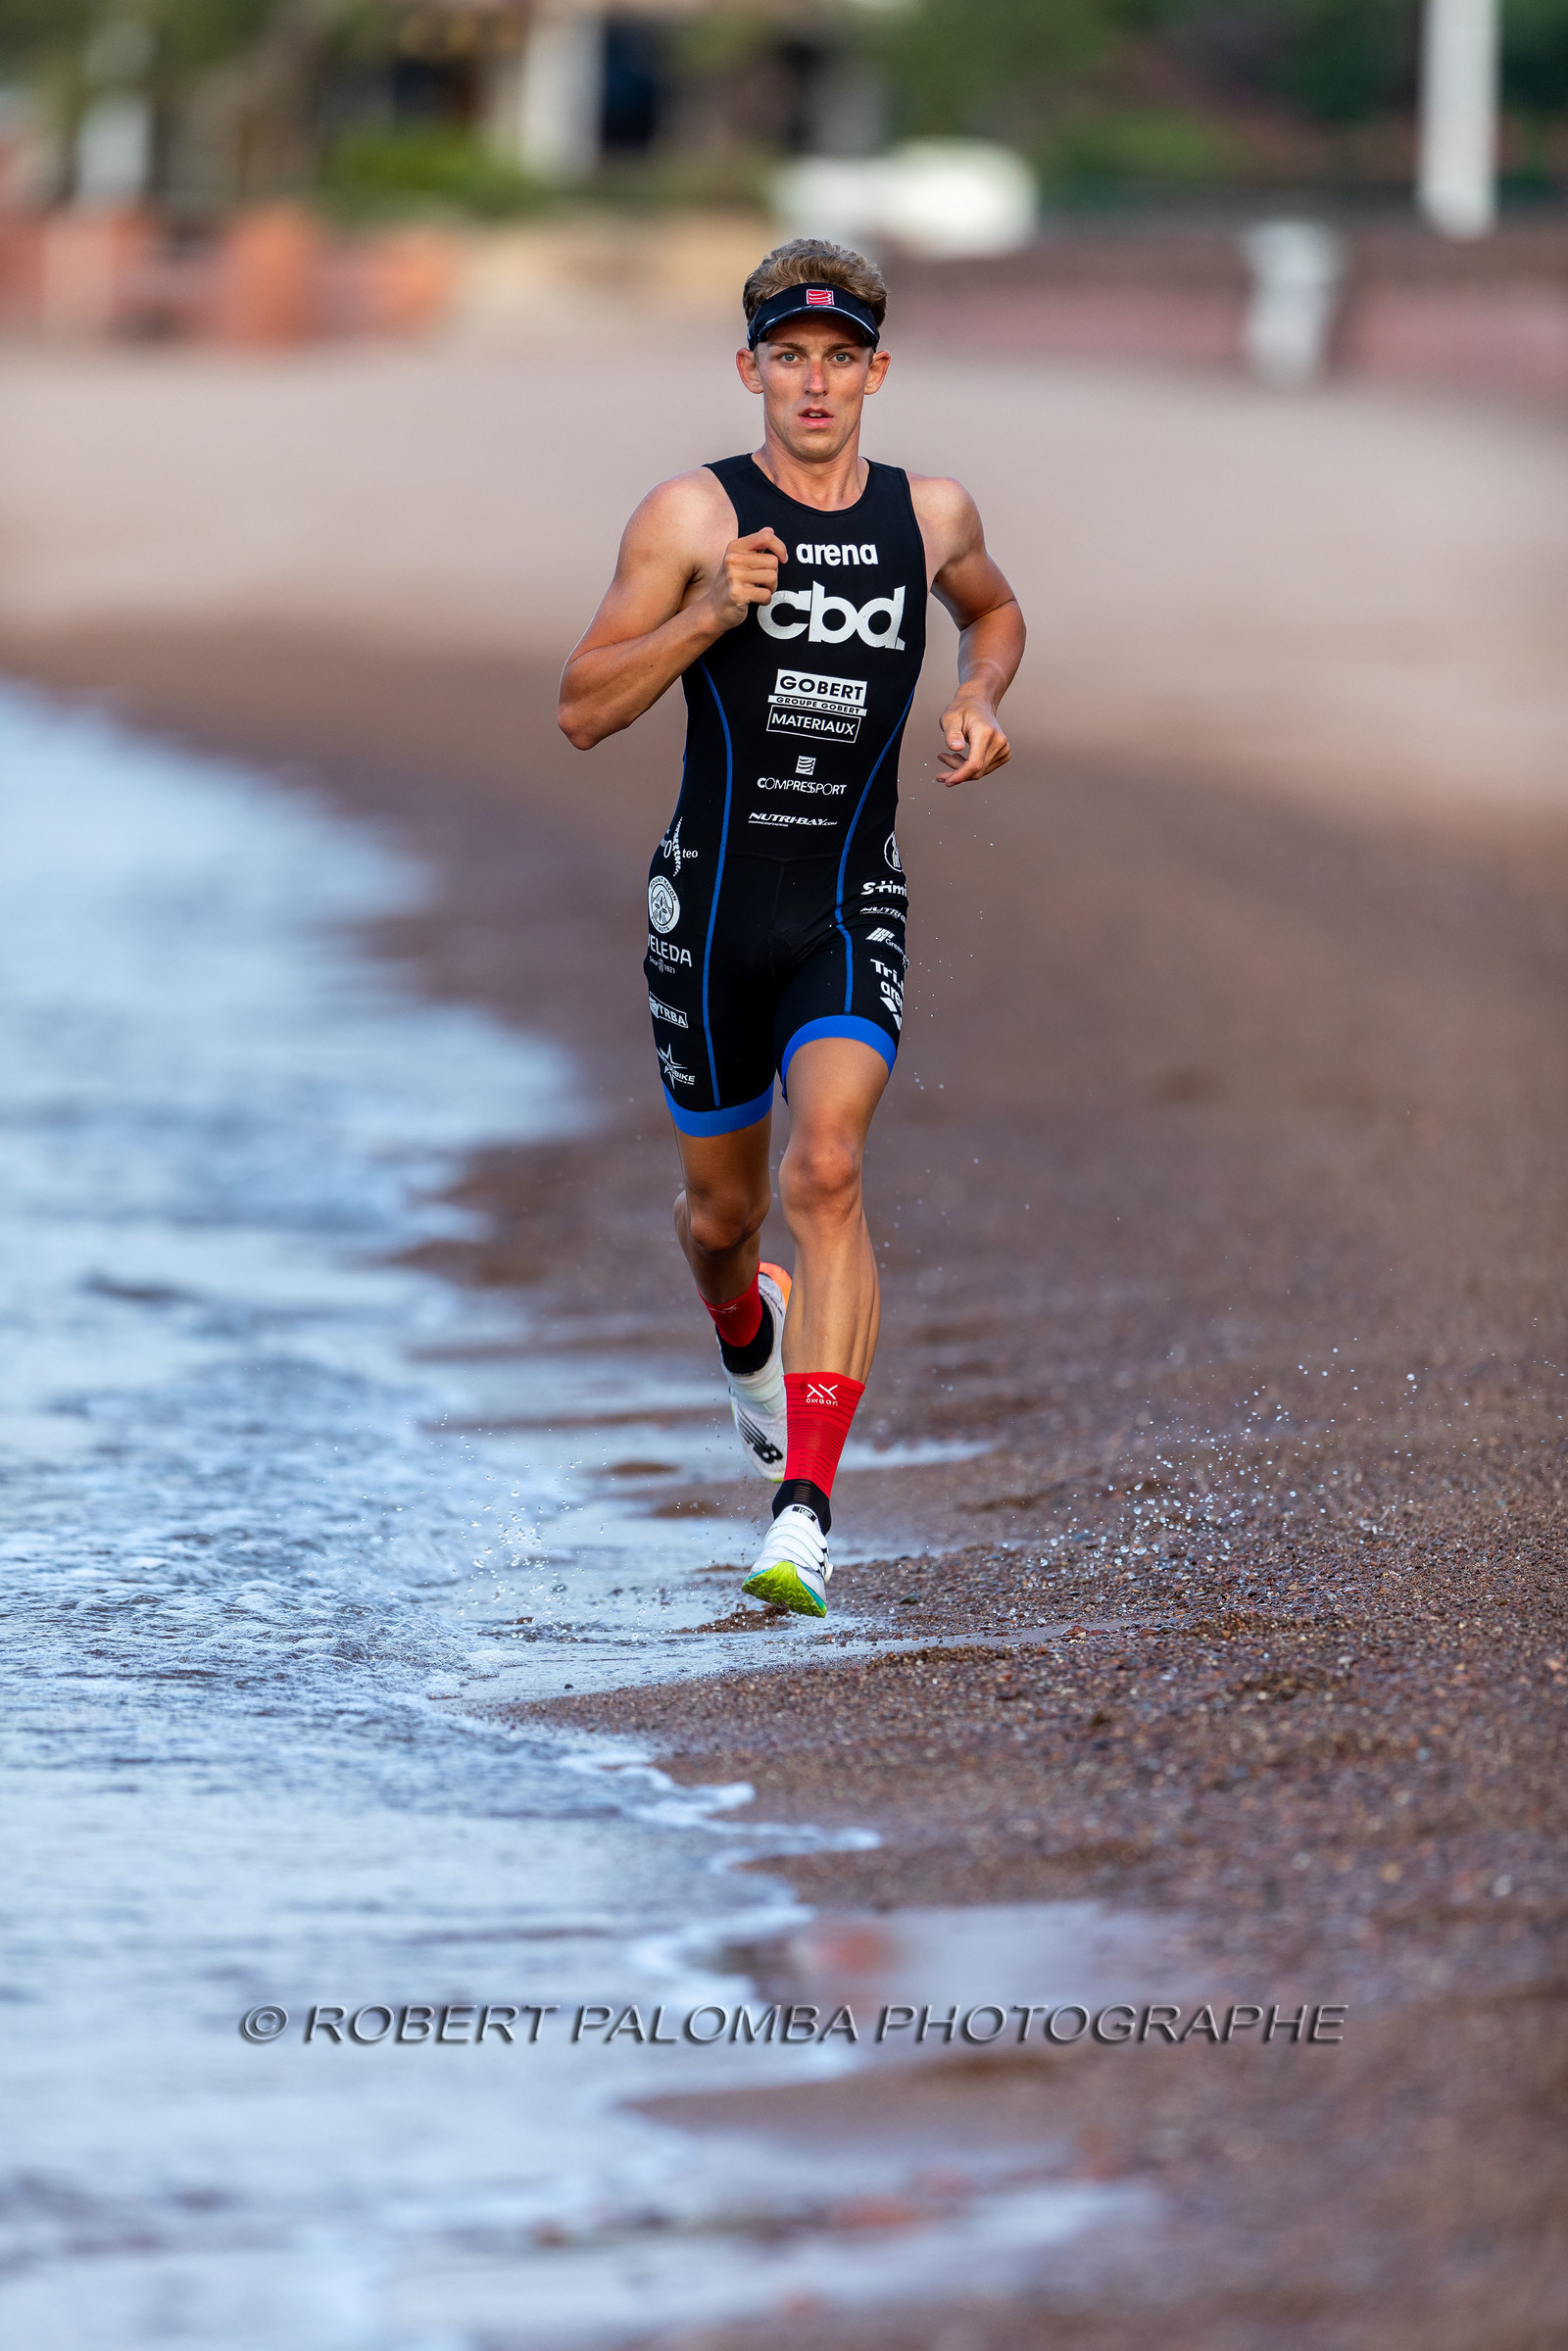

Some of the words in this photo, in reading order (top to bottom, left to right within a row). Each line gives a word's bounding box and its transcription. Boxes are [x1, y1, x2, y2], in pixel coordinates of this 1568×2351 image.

[796, 543, 879, 566] arena
[757, 580, 906, 651] cbd
[779, 675, 864, 701] GOBERT
[776, 696, 818, 708] GROUPE
[821, 702, 860, 714] GOBERT
[771, 712, 857, 735] MATERIAUX
[757, 777, 847, 796] COMPRESSPORT
[880, 981, 904, 1015] are
